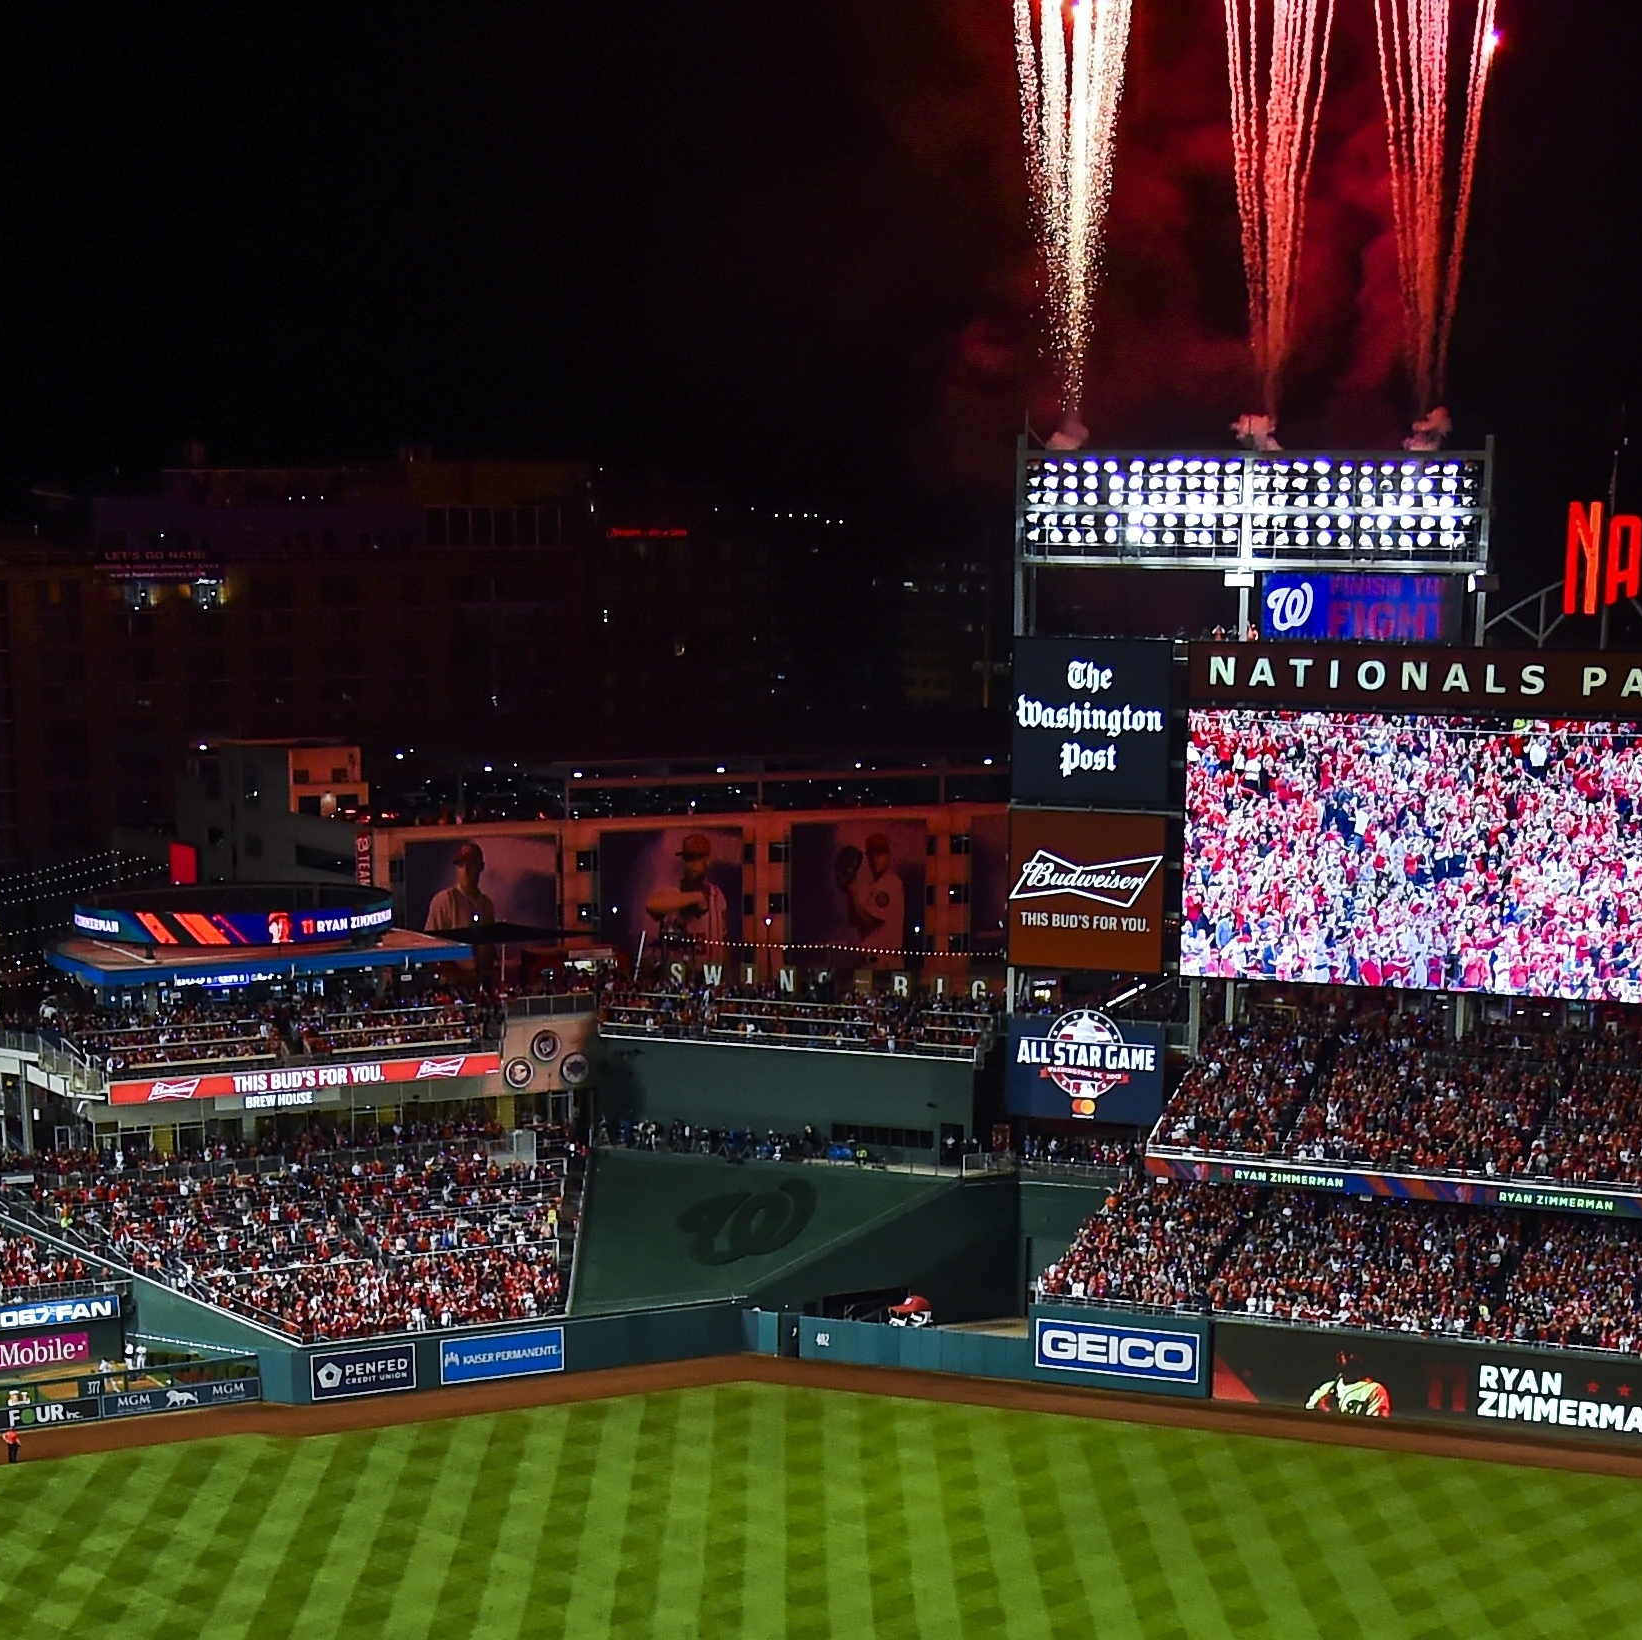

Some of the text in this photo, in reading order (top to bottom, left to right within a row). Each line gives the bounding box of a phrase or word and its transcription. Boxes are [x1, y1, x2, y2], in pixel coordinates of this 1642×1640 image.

[145, 551, 164, 560] GO
[1412, 576, 1447, 593] TH
[1067, 659, 1113, 695] The
[1208, 655, 1547, 696] NATIONALS
[1016, 695, 1164, 738] Washington
[1060, 741, 1118, 777] Post
[1023, 861, 1146, 892] Budweiser
[316, 916, 348, 933] RYAN
[1021, 911, 1151, 933] THIS BUD'S FOR YOU.
[1017, 1039, 1156, 1072] ALL STAR GAME
[233, 1065, 385, 1093] THIS BUD'S FOR YOU.
[245, 1091, 314, 1109] BREW HOUSE
[1234, 1170, 1344, 1188] RYAN ZIMMERMAN
[1499, 1191, 1614, 1211] RYAN ZIMMERMAN
[57, 1301, 113, 1322] FAN
[815, 1333, 830, 1347] 402
[463, 1351, 494, 1367] KAISER
[1039, 1327, 1194, 1376] GEICO
[344, 1358, 409, 1378] PENFED
[345, 1370, 409, 1385] CREDIT UNION
[86, 1380, 101, 1396] 377
[212, 1382, 245, 1396] MGM
[1478, 1365, 1563, 1396] RYAN
[117, 1394, 151, 1408] MGM
